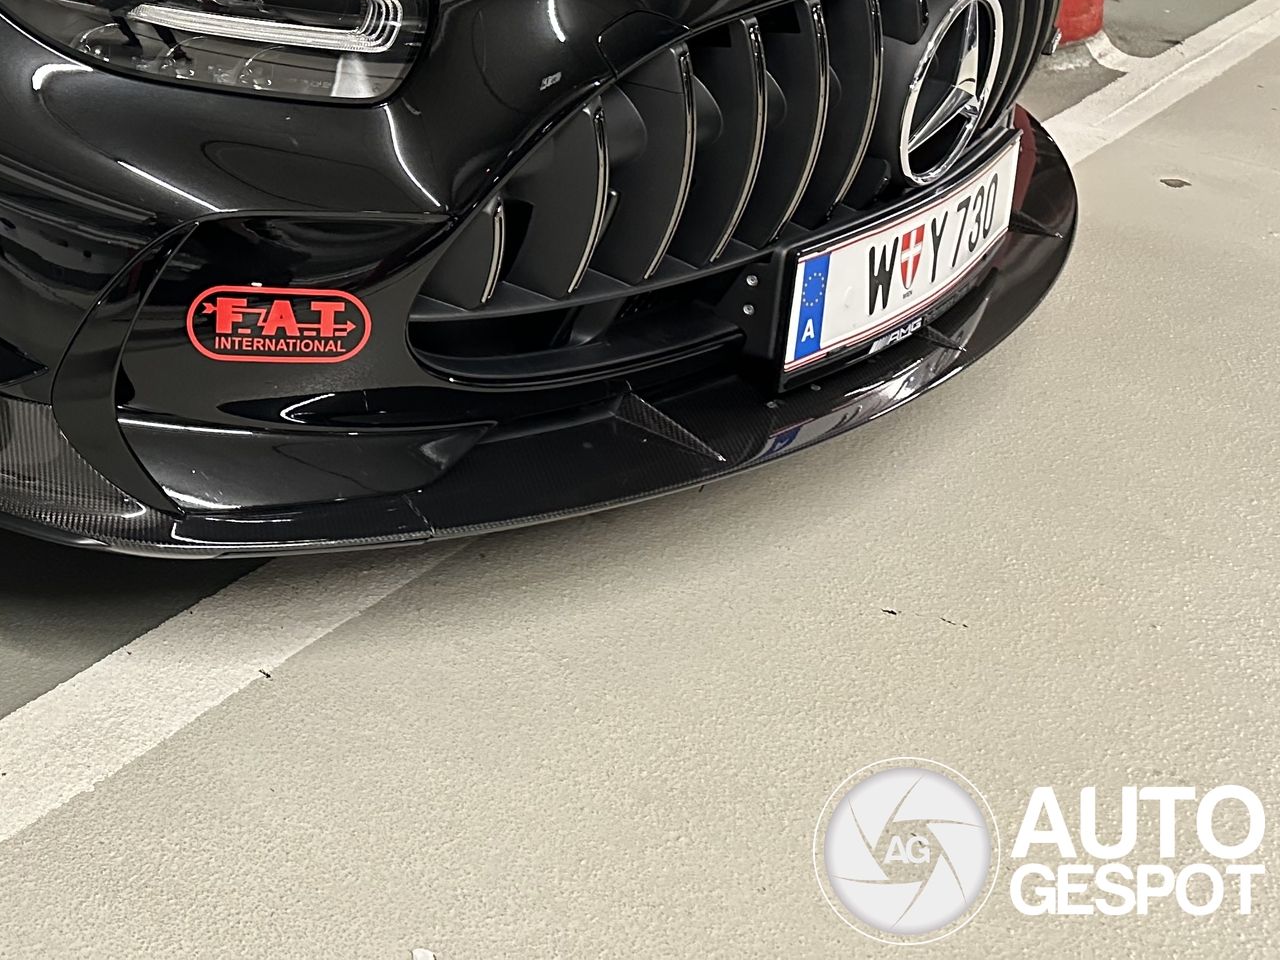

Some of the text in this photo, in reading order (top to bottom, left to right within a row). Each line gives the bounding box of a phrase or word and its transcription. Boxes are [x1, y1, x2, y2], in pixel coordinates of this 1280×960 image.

[868, 172, 999, 317] W Y 730
[801, 318, 815, 343] A
[214, 336, 347, 353] INTERNATIONAL
